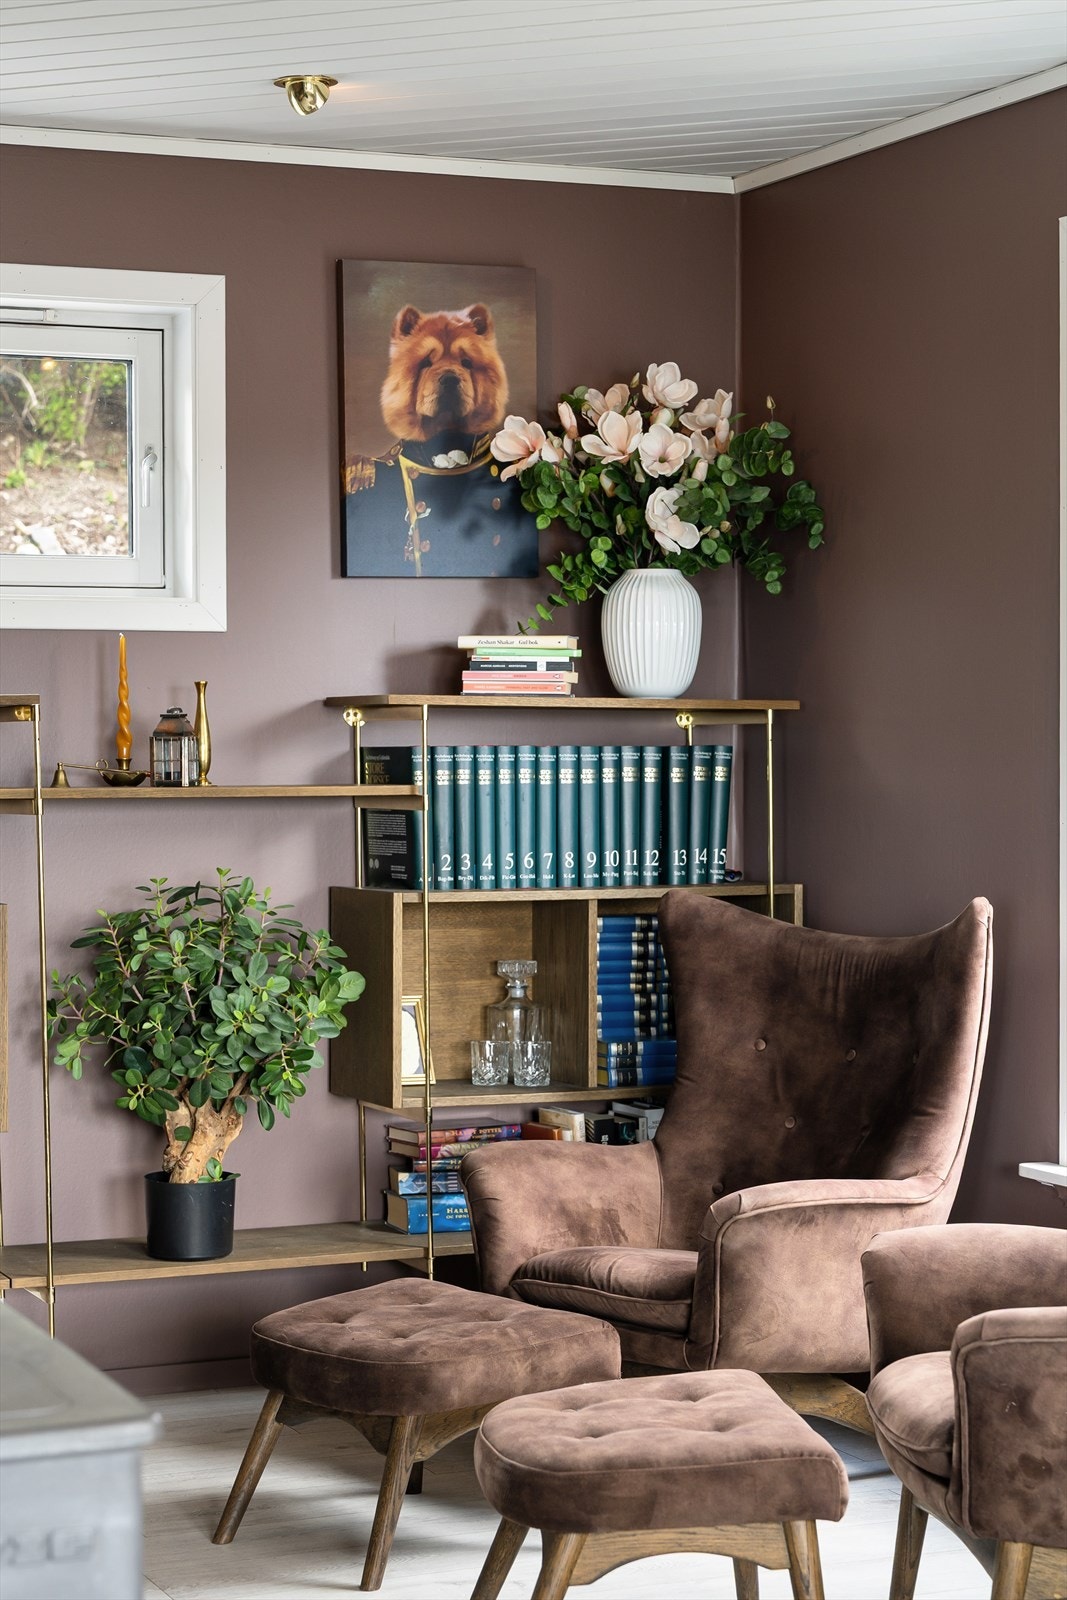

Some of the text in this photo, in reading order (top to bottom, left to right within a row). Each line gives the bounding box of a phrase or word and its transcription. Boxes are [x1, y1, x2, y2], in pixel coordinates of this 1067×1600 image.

[441, 854, 452, 870] 2
[461, 854, 470, 870] 3
[482, 853, 493, 870] 4
[504, 852, 514, 870] 5
[524, 852, 534, 868] 6
[543, 852, 553, 869] 7
[565, 852, 574, 868] 8
[586, 852, 596, 868] 9
[604, 850, 619, 866] 10
[625, 850, 638, 866] 11
[644, 850, 659, 866] 12
[673, 850, 687, 866] 13
[694, 848, 707, 864] 14
[713, 848, 726, 864] 15
